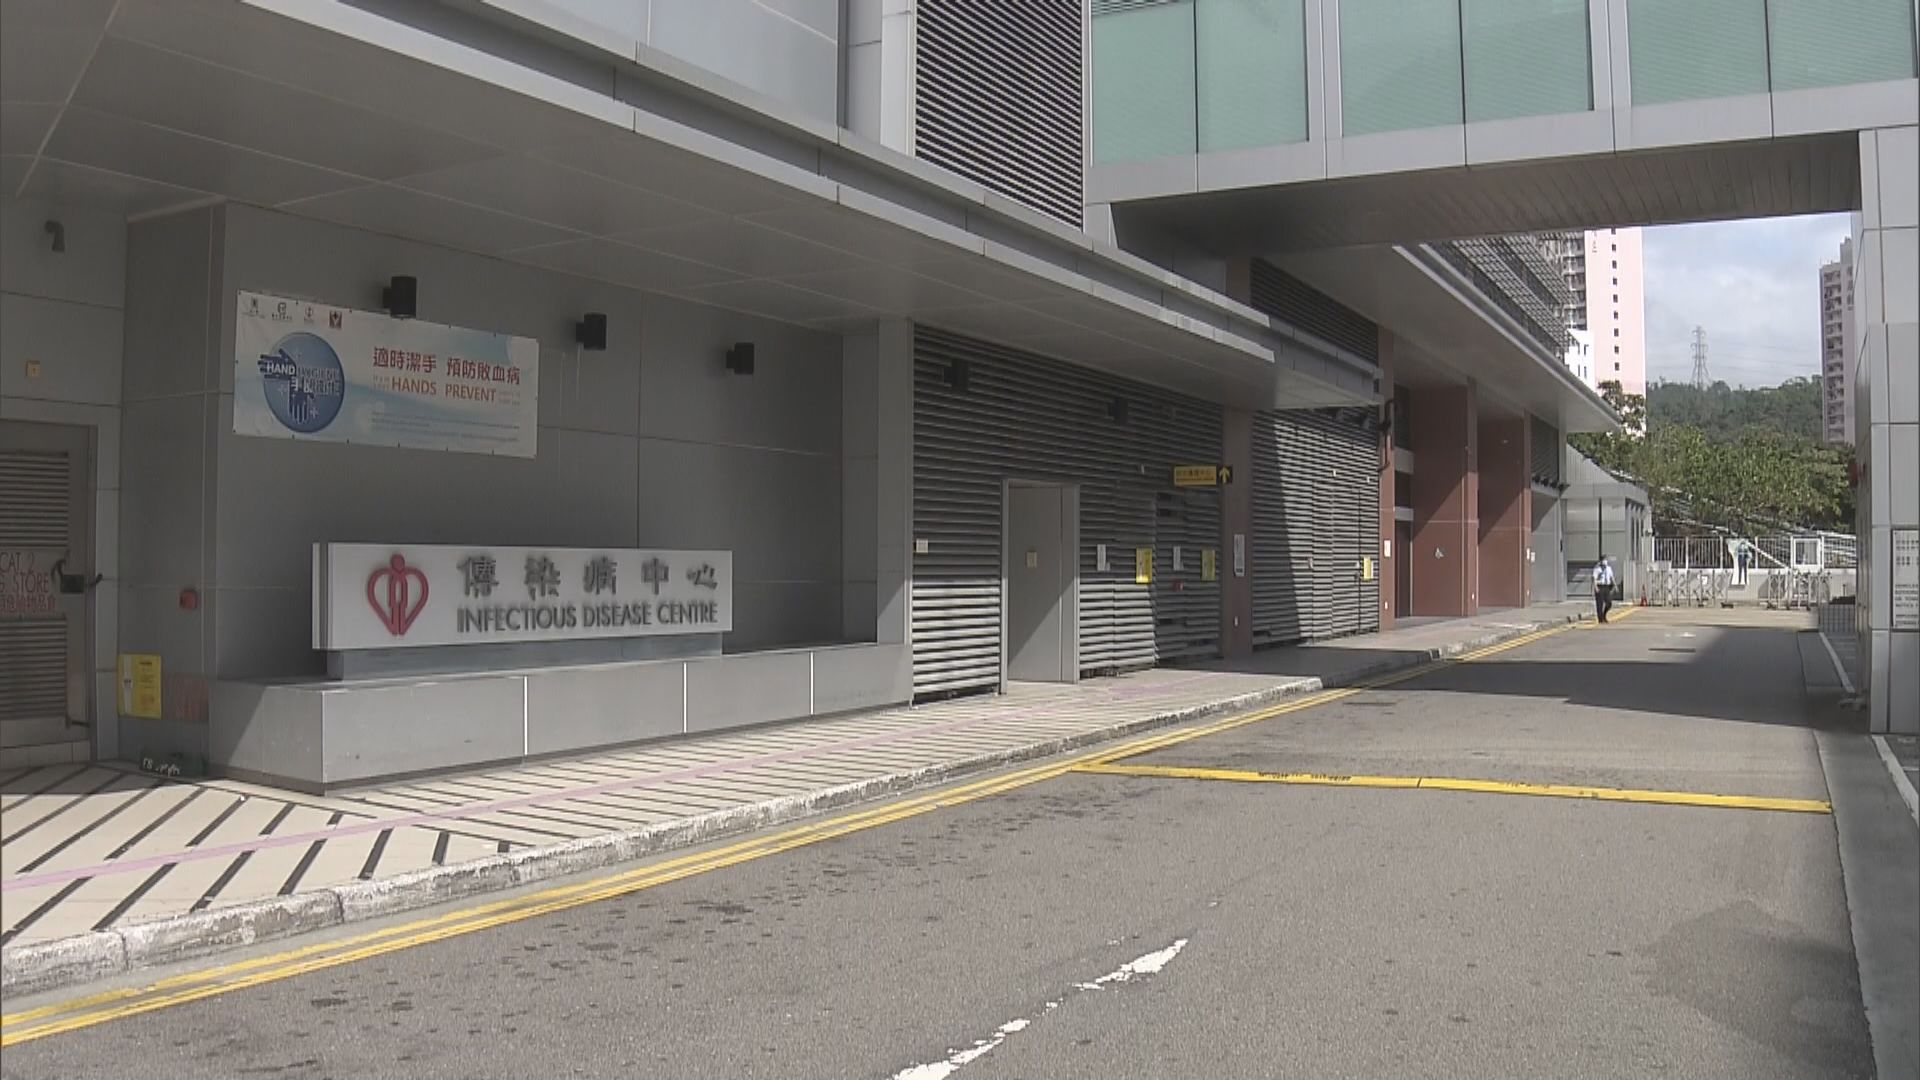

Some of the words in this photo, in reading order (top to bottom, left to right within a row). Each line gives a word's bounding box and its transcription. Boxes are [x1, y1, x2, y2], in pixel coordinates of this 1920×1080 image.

[267, 361, 297, 375] HAND
[372, 346, 437, 373] 適時潔手
[446, 356, 521, 385] 預防敗血病
[391, 376, 437, 396] HANDS
[445, 382, 497, 403] PREVENT
[13, 572, 49, 593] STORE
[455, 556, 719, 602] 傳染病中心
[456, 606, 577, 634] INFECTIOUS
[582, 604, 652, 628] DISEASE
[657, 601, 720, 625] CENTRE
